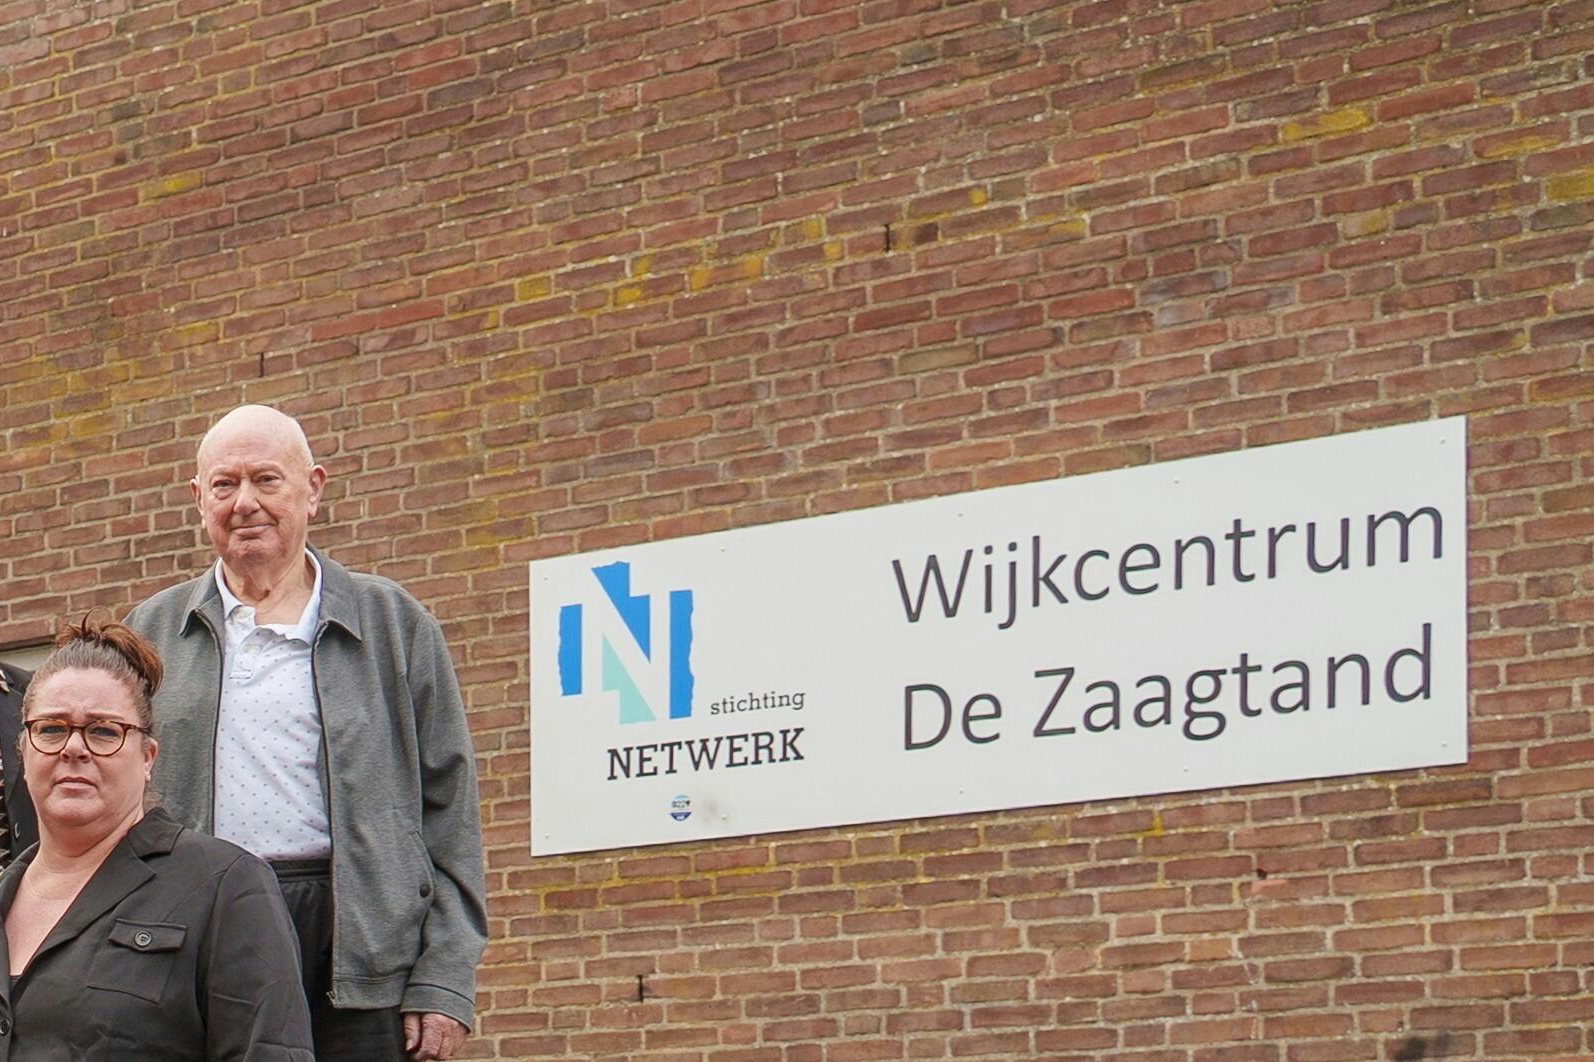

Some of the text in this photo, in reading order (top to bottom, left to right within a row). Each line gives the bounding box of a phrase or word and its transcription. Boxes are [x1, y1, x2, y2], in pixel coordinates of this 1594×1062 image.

[891, 505, 1443, 630] Wijkcentrum
[709, 690, 806, 716] stichting
[903, 622, 1433, 752] De Zaagtand
[606, 727, 806, 781] NETWERK
